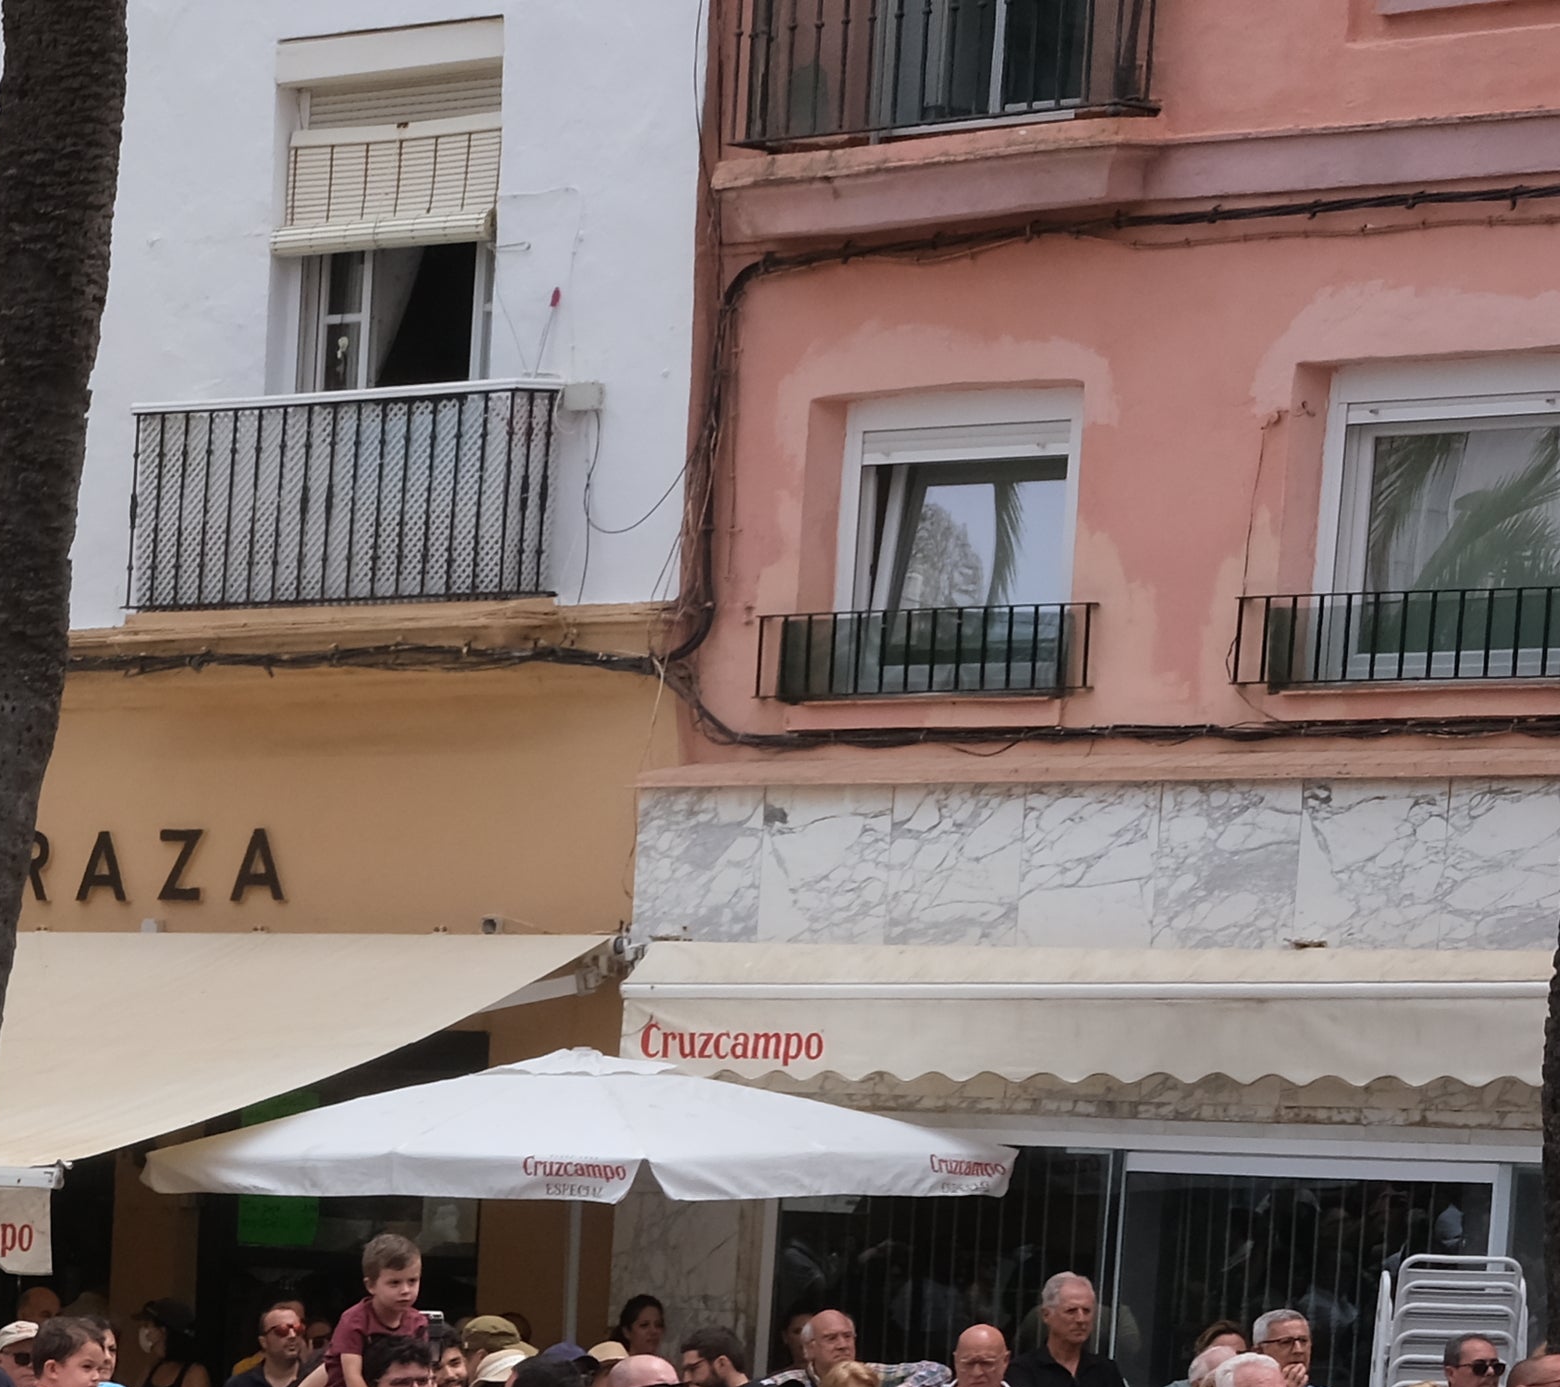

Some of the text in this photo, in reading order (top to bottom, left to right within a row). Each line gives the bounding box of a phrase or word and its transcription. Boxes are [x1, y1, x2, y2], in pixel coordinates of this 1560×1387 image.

[640, 1021, 824, 1067] Cruzcampo
[523, 1156, 627, 1183] Cruzcampo
[930, 1154, 1006, 1177] Cruzcampo
